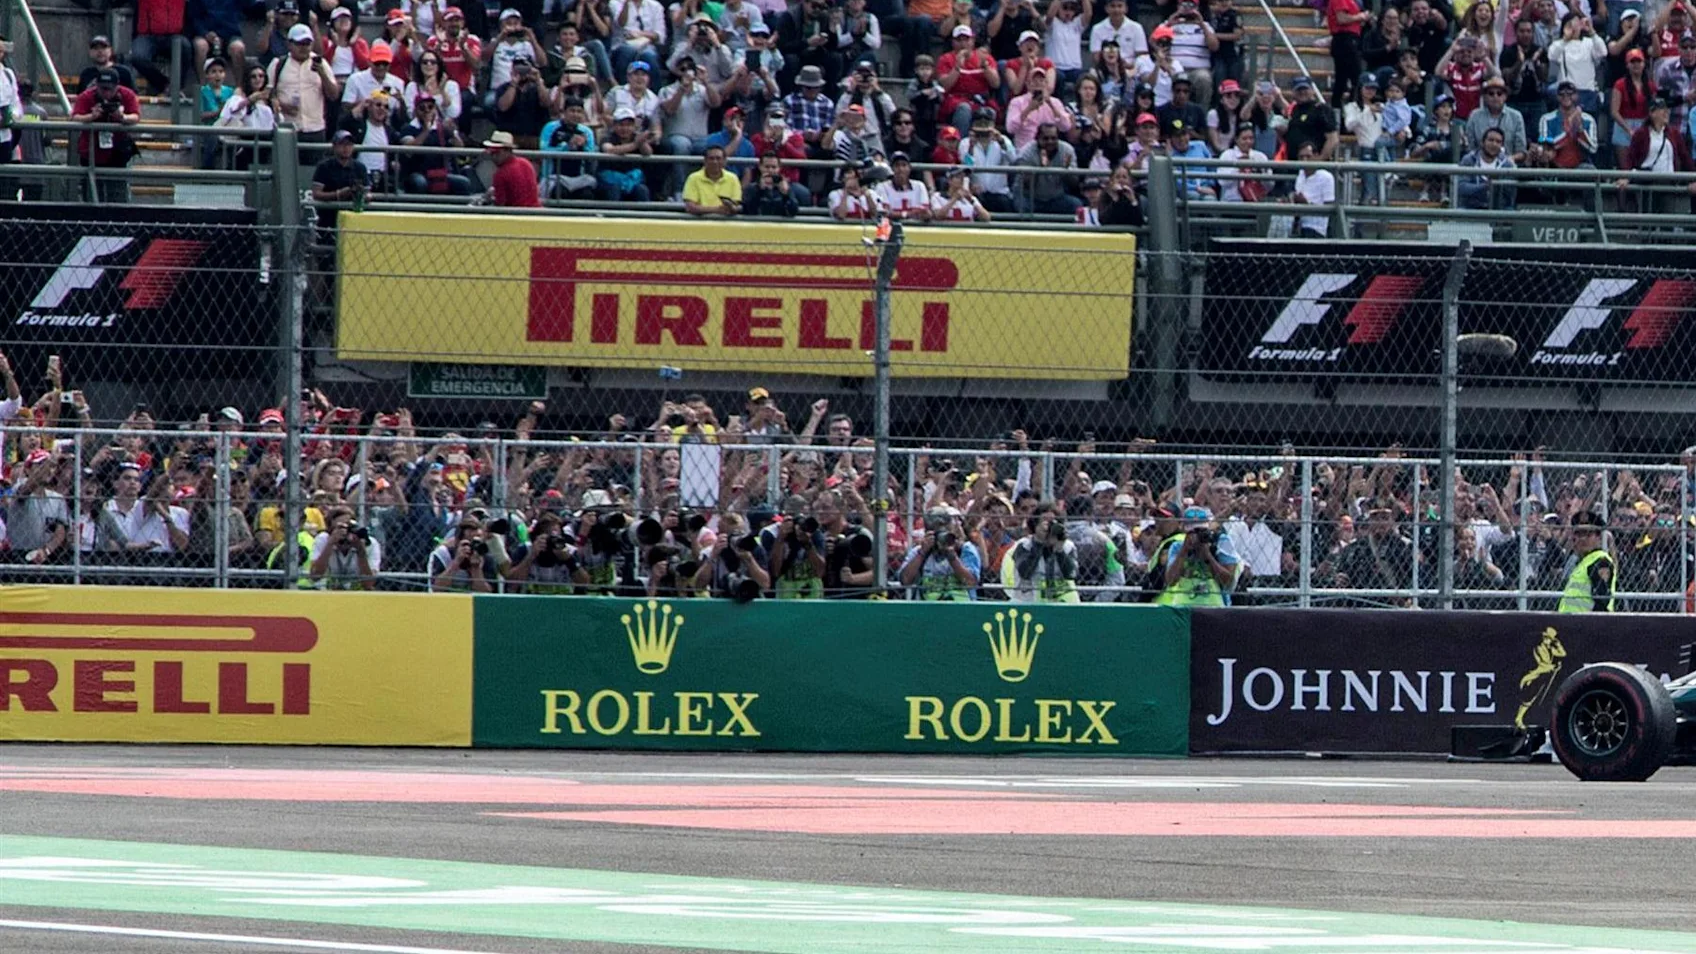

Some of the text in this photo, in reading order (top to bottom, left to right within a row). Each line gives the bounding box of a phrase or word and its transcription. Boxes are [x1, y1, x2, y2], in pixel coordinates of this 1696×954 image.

[1532, 227, 1579, 243] VE10
[527, 247, 959, 352] PIRELLI
[16, 310, 116, 327] Formula 1
[1248, 345, 1340, 361] Formula 1
[1531, 350, 1621, 365] Formula 1
[430, 379, 526, 394] EMERGENCIA
[1206, 658, 1496, 726] JOHNNIE
[540, 690, 761, 737] ROLEX
[904, 697, 1119, 745] ROLEX
